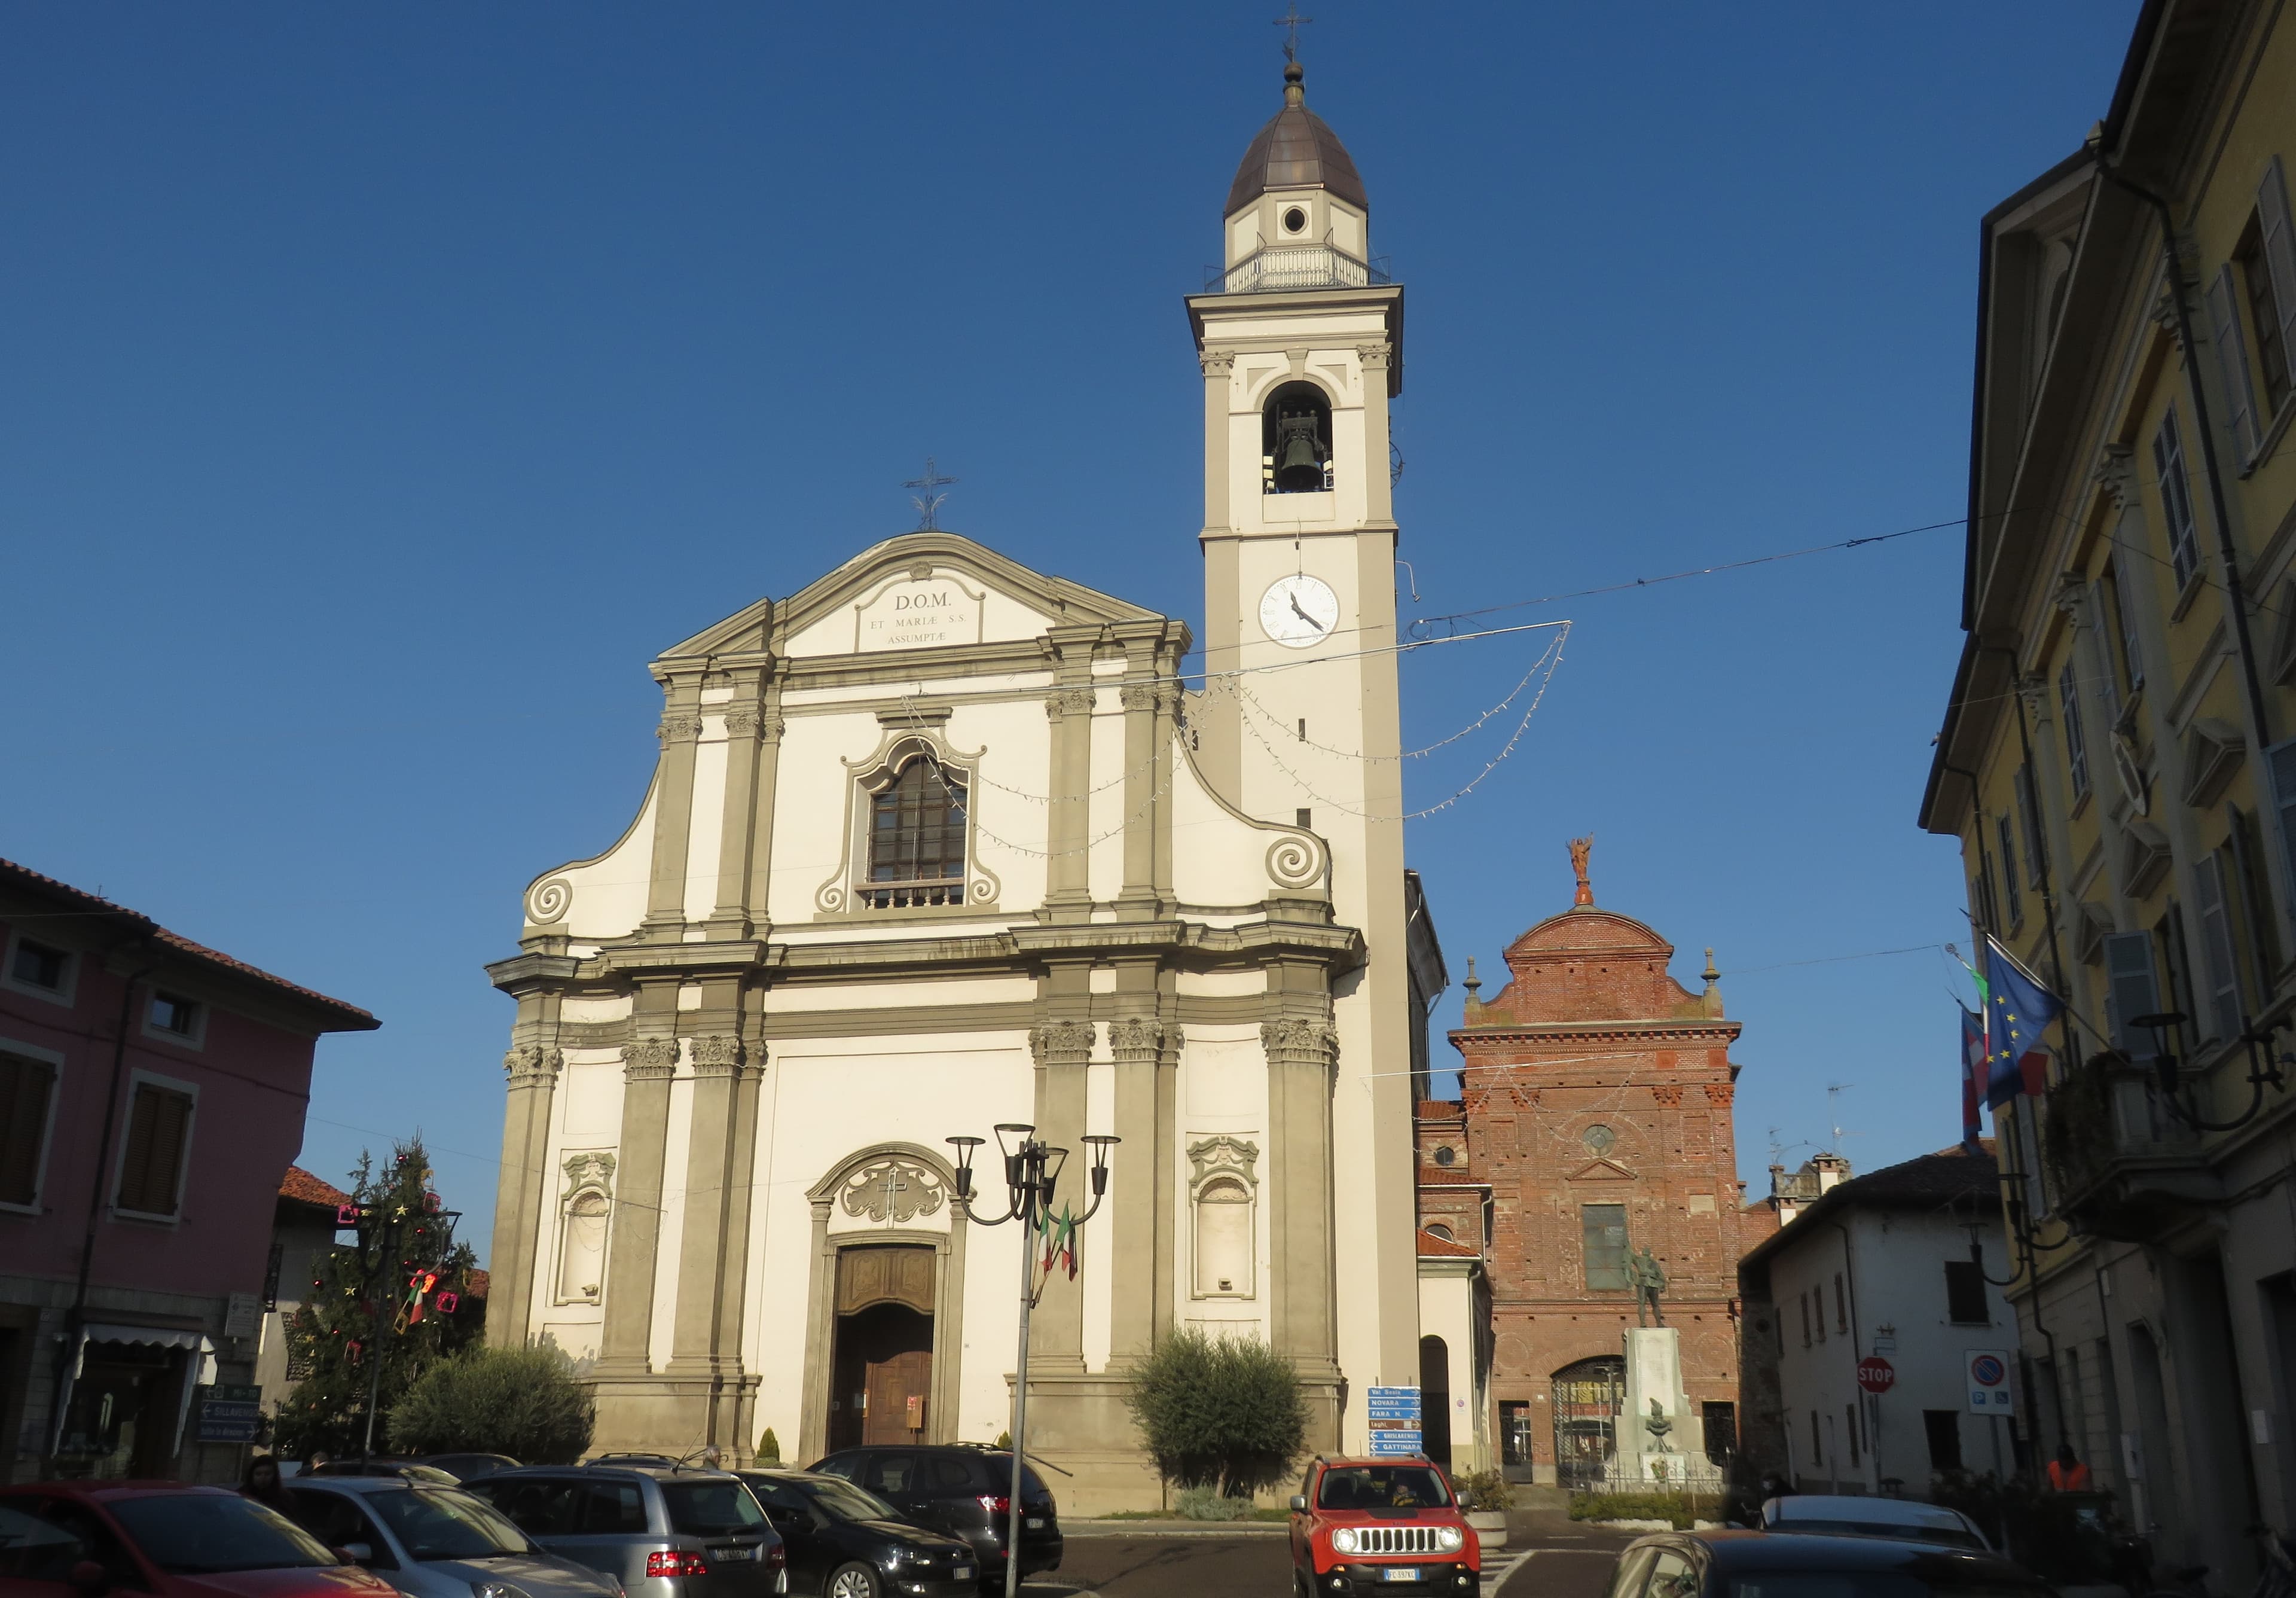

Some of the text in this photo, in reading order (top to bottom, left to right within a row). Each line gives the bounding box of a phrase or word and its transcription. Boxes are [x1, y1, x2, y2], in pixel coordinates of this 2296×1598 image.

[895, 592, 951, 610] D.O.M.
[871, 620, 884, 629] ET
[1859, 1367, 1892, 1383] STOP
